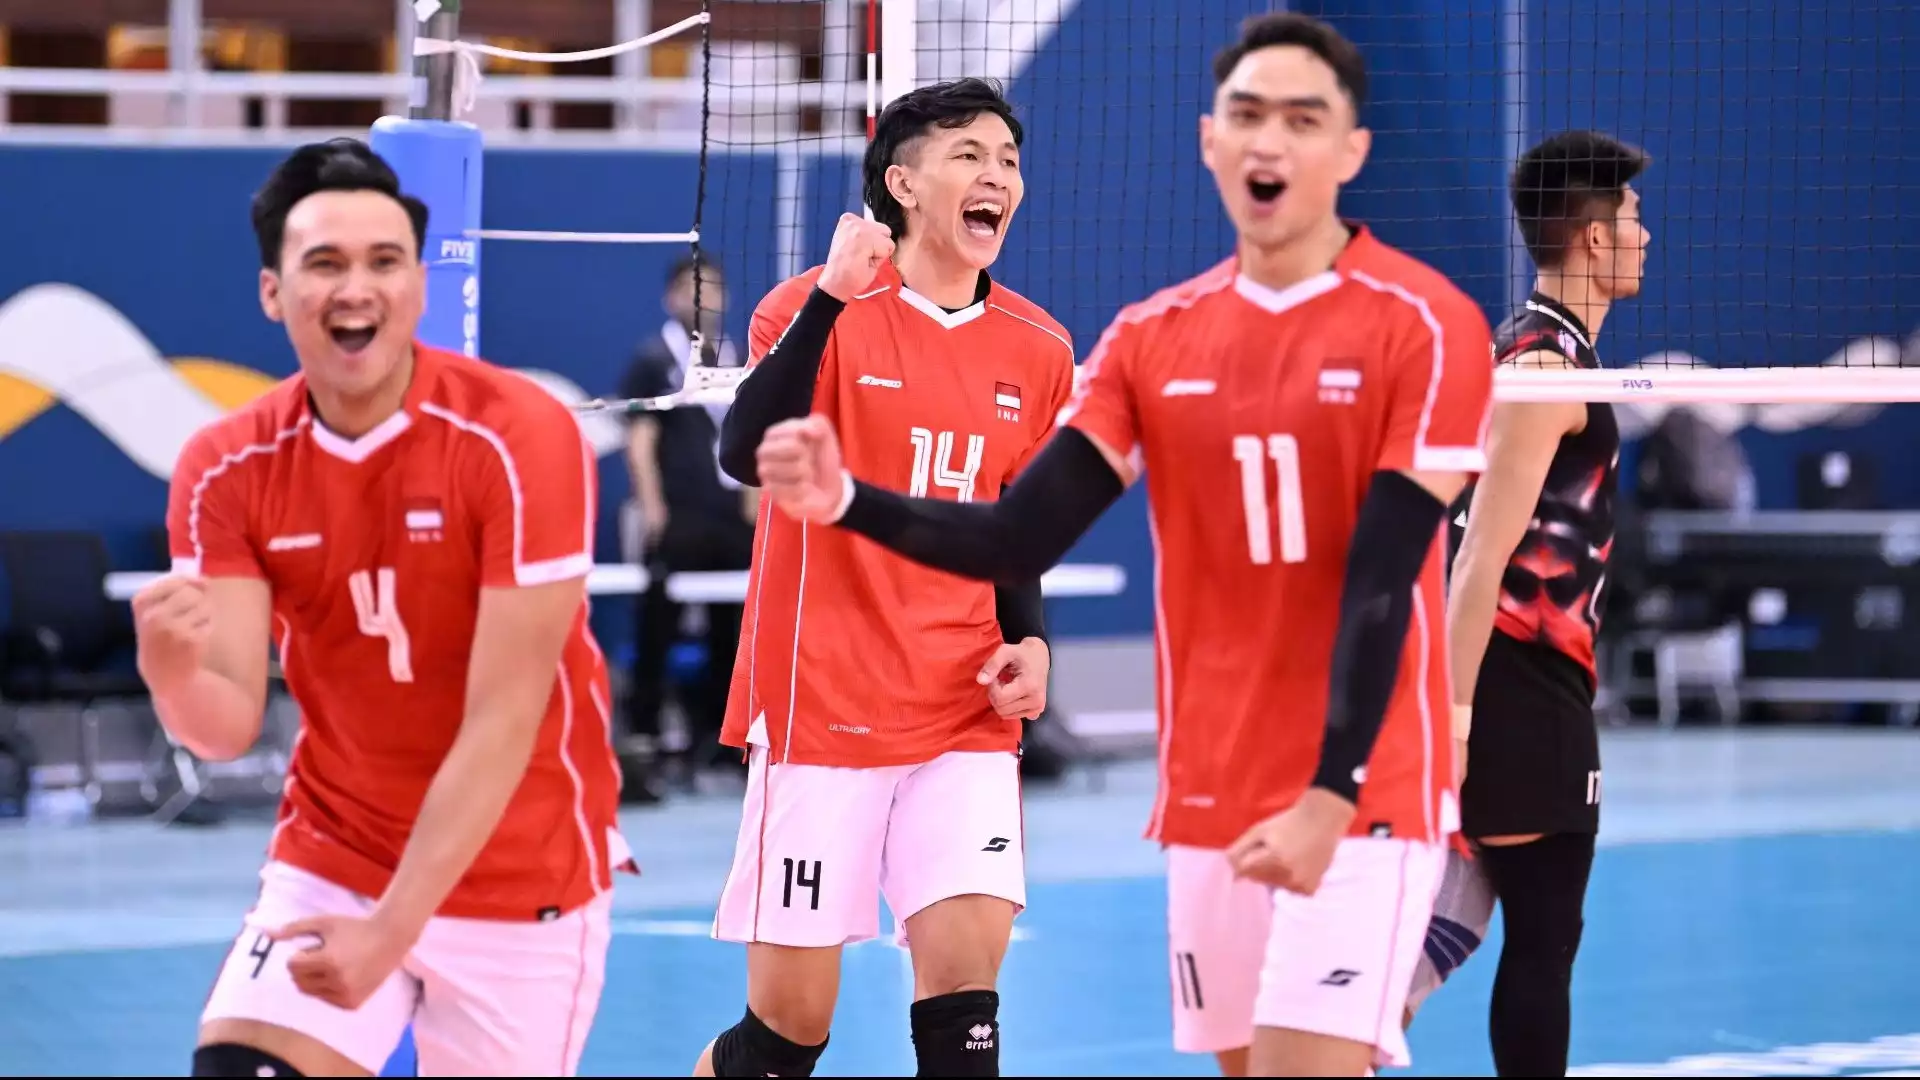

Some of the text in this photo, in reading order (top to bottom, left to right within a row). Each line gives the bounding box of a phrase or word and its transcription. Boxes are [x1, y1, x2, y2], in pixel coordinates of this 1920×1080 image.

[997, 408, 1019, 423] INA
[910, 426, 985, 503] 14
[1233, 433, 1308, 566] 11
[348, 566, 415, 684] 4
[783, 857, 822, 911] 14
[250, 932, 275, 980] 4
[1176, 952, 1204, 1010] 11
